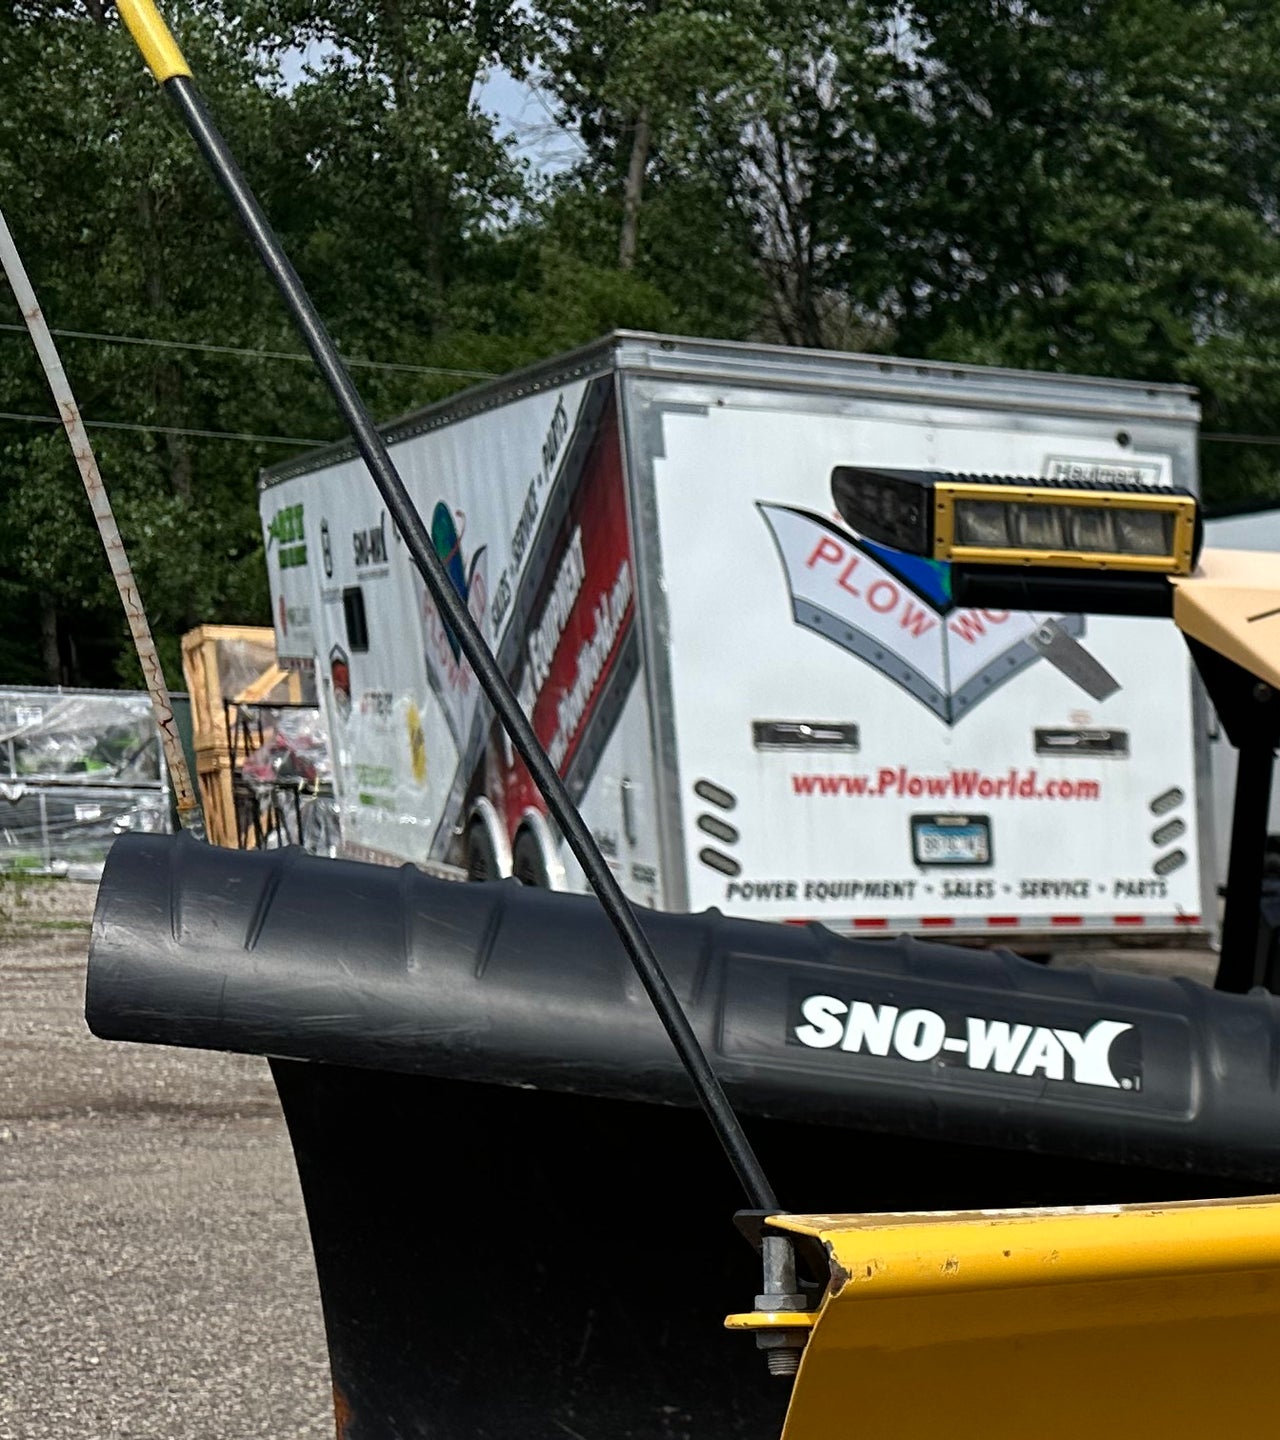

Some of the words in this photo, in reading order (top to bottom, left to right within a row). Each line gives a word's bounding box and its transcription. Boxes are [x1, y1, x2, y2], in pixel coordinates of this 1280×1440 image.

[806, 535, 937, 639] PLOW
[791, 766, 1101, 799] www.PlowWorld.com
[726, 880, 798, 900] POWER
[803, 880, 916, 901] EQUIPMENT
[942, 880, 995, 899] SALES
[1018, 880, 1090, 899] SERVICE
[1112, 880, 1168, 899] PARTS
[794, 995, 1134, 1088] SNO-WAY
